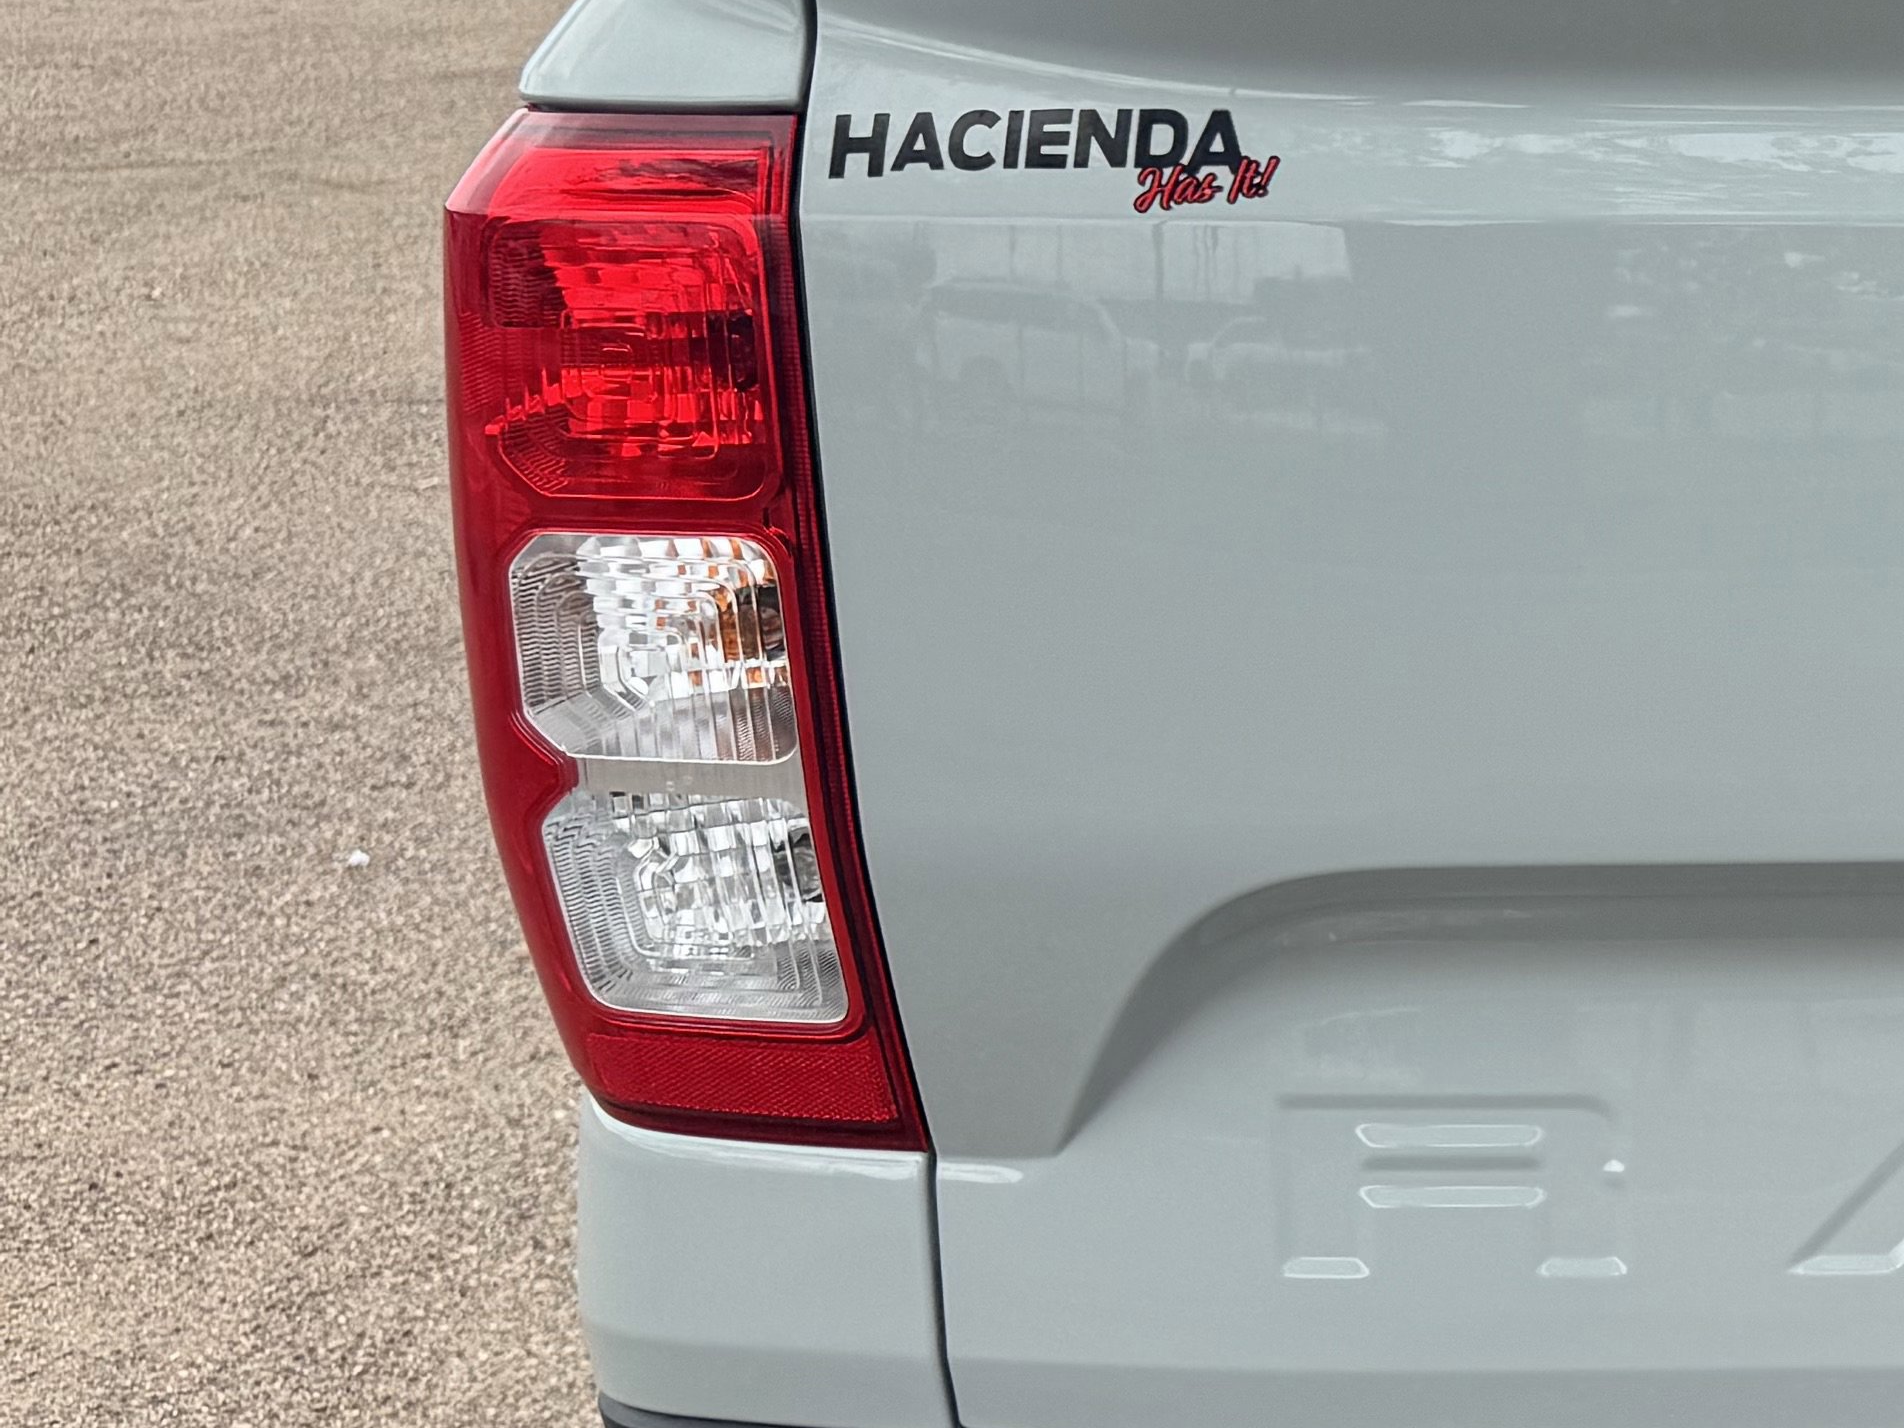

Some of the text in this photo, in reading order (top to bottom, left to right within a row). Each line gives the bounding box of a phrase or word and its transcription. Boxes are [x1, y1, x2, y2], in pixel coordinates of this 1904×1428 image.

[828, 108, 1243, 179] HACIENDA
[1133, 155, 1281, 214] Has It!
